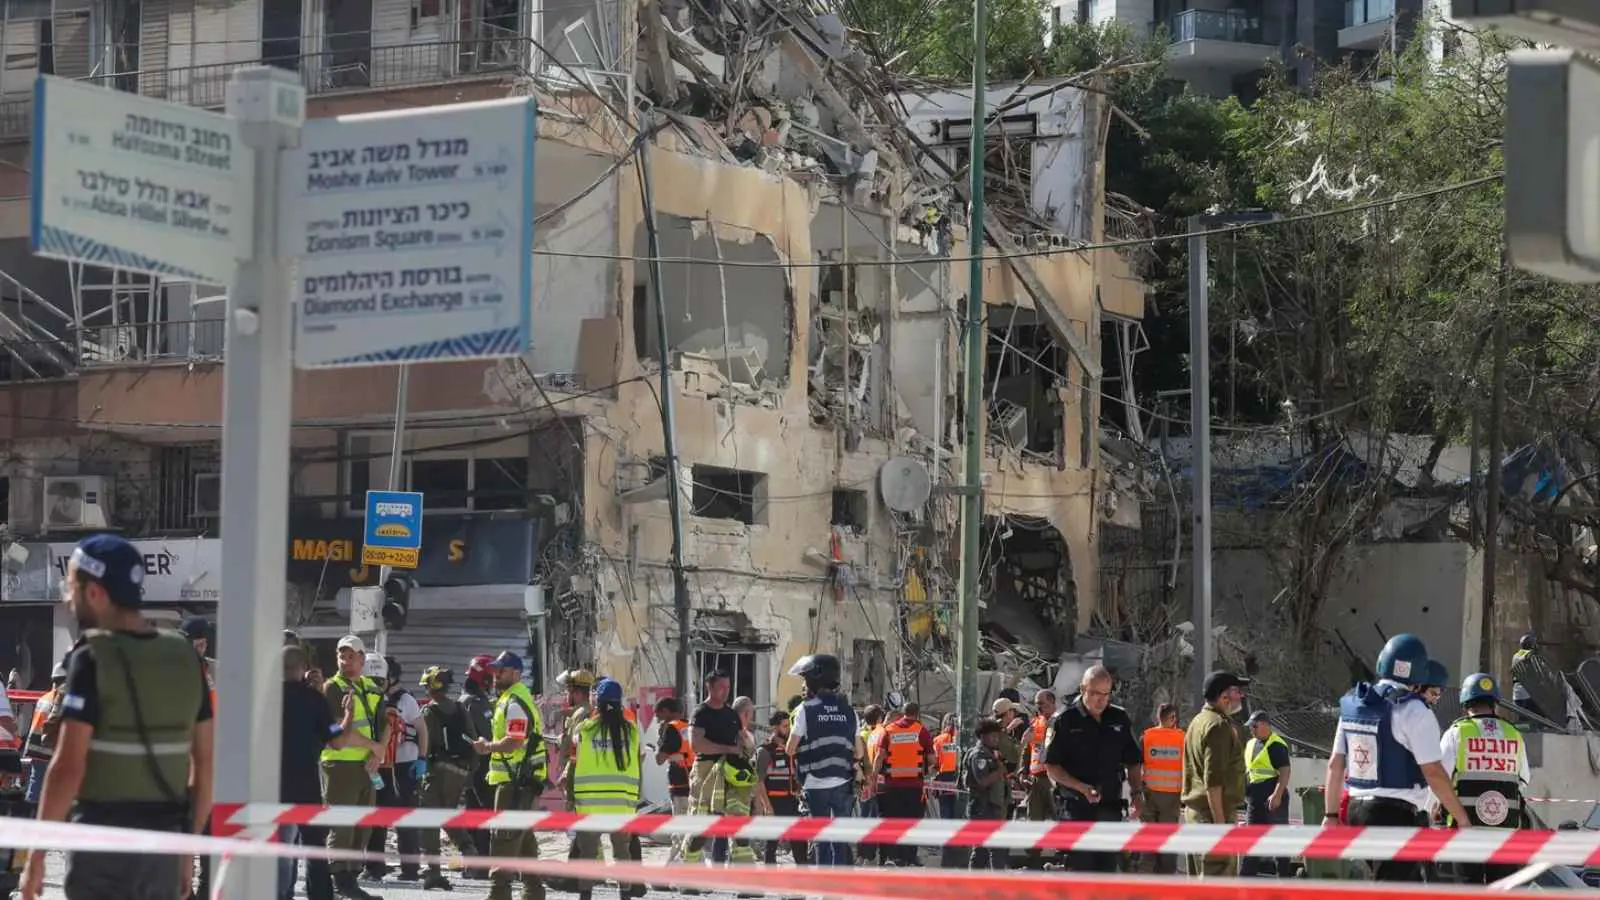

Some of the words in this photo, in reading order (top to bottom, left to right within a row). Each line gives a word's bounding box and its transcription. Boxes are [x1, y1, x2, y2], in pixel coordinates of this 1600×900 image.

[126, 113, 185, 142] היוזמה
[191, 127, 231, 150] רחוב
[185, 146, 231, 170] Street
[309, 148, 355, 169] אביב
[361, 143, 410, 164] משה
[417, 137, 469, 160] מגדל
[77, 169, 130, 196] סילבר
[307, 170, 361, 190] Moshe
[366, 166, 400, 185] Aviv
[408, 164, 460, 182] Tower
[135, 177, 169, 204] הלל
[174, 189, 211, 212] אבא
[92, 195, 128, 217] Abba
[131, 202, 168, 223] Hillel
[172, 209, 210, 231] Silver
[342, 205, 419, 228] הציונות
[425, 201, 471, 221] כיכר
[306, 234, 369, 253] Zionism
[374, 230, 434, 250] Square
[304, 270, 393, 294] היהלומים
[400, 266, 462, 289] בורסת
[304, 295, 376, 315] Diamond
[381, 290, 463, 312] Exchange
[293, 538, 353, 561] MAGI
[1467, 737, 1518, 754] חובש
[1467, 756, 1516, 772] הצלה
